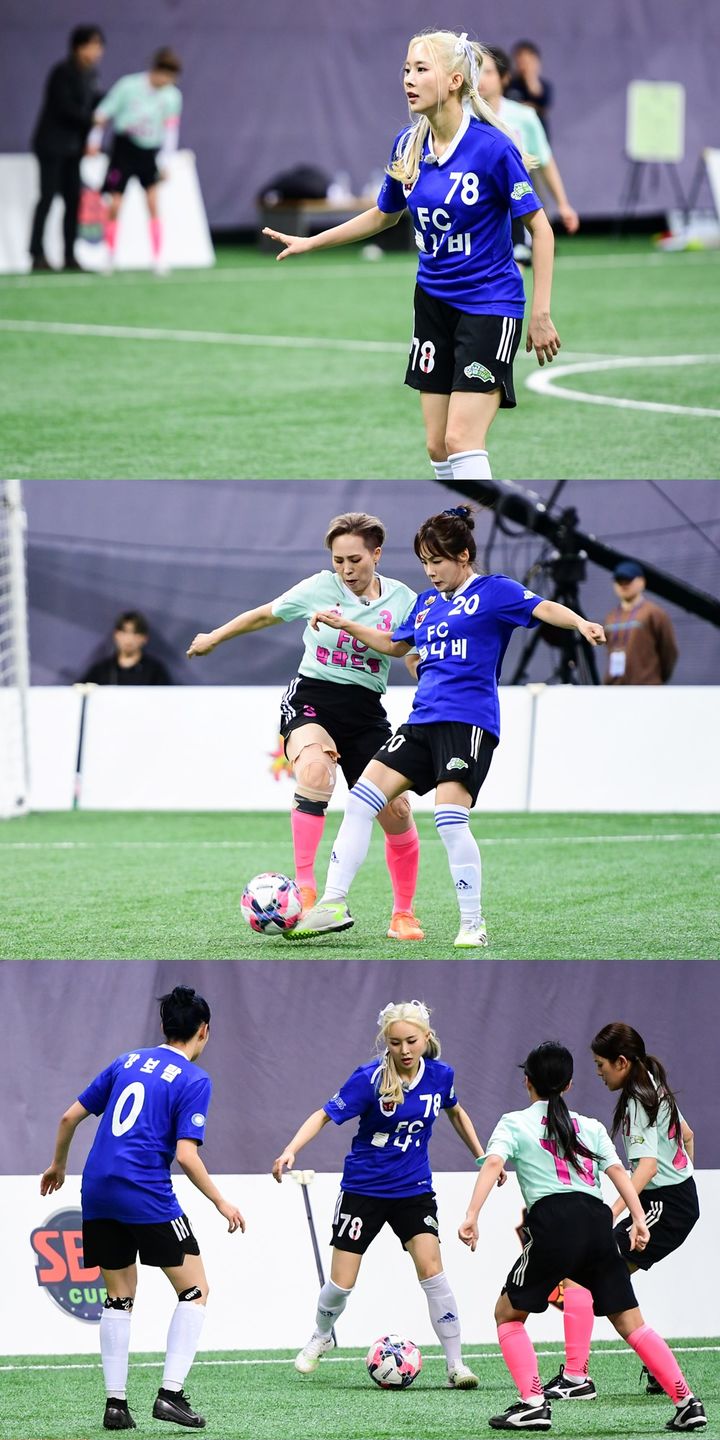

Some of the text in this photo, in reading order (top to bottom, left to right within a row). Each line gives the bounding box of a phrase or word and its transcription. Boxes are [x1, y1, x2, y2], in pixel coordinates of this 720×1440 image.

[444, 172, 479, 206] 78
[416, 207, 452, 231] FC
[409, 337, 436, 374] 78
[448, 594, 480, 616] 20
[376, 610, 393, 633] 3
[427, 621, 449, 642] FC
[303, 704, 318, 718] 3
[380, 734, 407, 753] 0
[112, 1081, 145, 1137] 0
[419, 1093, 441, 1118] 78
[395, 1120, 424, 1134] FC
[337, 1213, 363, 1240] 78
[33, 1231, 102, 1283] SB
